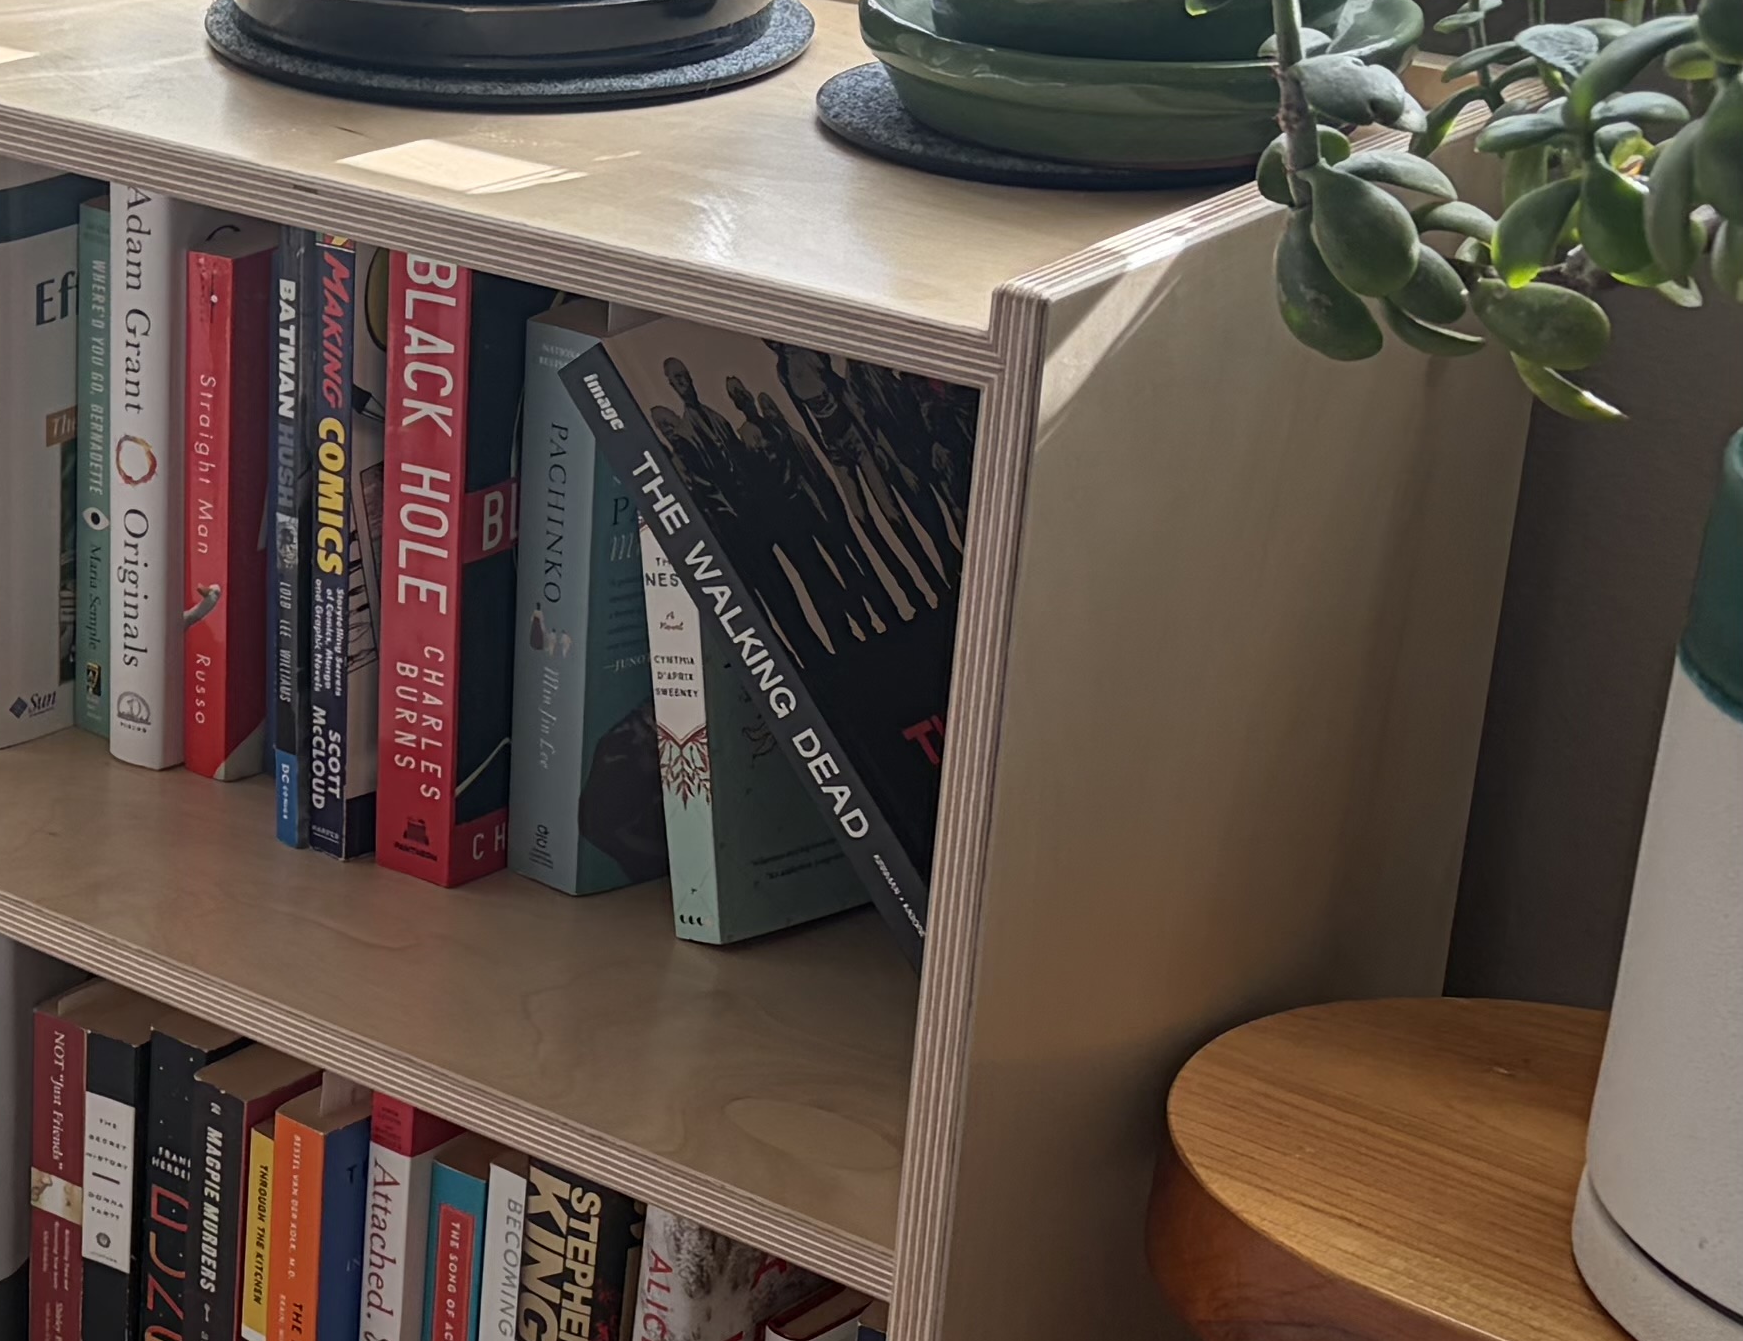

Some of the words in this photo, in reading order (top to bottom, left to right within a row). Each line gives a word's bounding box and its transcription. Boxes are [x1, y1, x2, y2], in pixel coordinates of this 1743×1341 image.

[125, 185, 153, 292] Adam
[91, 259, 106, 330] WHERE'D
[90, 332, 105, 368] YOU
[278, 277, 297, 420] BATMAN
[321, 250, 351, 410] MAKING
[401, 253, 458, 438] BLACK
[124, 308, 152, 414] Grant
[89, 403, 104, 496] BERNADETTE
[194, 374, 217, 485] Straight
[276, 422, 296, 509] HUSH
[316, 416, 346, 576] COMICS
[543, 421, 569, 605] PACHINKO
[197, 498, 214, 555] Man
[397, 462, 452, 615] HOLE
[88, 543, 102, 592] Maria
[117, 508, 150, 668] Originals
[314, 578, 323, 595] and
[645, 572, 680, 588] NES
[86, 594, 102, 651] Semple
[278, 581, 292, 610] LOEB
[312, 597, 324, 645] Graphic
[334, 587, 345, 650] Storytelling
[583, 372, 625, 431] image
[632, 450, 690, 536] THE
[684, 539, 797, 720] WALKING
[792, 727, 870, 840] DEAD
[278, 619, 292, 639] LEE
[278, 649, 292, 703] WILLIAMS
[313, 648, 322, 693] Novels
[323, 648, 333, 690] Manga
[334, 652, 344, 697] Secrets
[653, 655, 695, 666] CYNTHIA
[29, 689, 58, 711] Sun
[195, 653, 211, 725] Russo
[393, 661, 419, 771] BURNS
[655, 687, 700, 699] SWEENEY
[419, 645, 446, 801] CHARLES
[280, 763, 290, 784] DC
[312, 705, 327, 810] McCLOUD
[327, 728, 341, 799] SCOTT
[53, 1029, 66, 1070] NOT
[88, 1134, 127, 1151] SECRET
[99, 1117, 117, 1130] THE
[86, 1151, 128, 1171] HISTORY
[203, 1126, 224, 1203] MAGPIE
[292, 1134, 303, 1170] BESSEL
[87, 1191, 124, 1209] DONNA
[91, 1205, 120, 1221] TARTT
[256, 1165, 269, 1223] THROUGH
[290, 1199, 300, 1221] DER
[291, 1175, 301, 1197] VAN
[200, 1203, 221, 1293] MURDERS
[255, 1226, 267, 1250] THE
[365, 1157, 402, 1319] Attached.
[449, 1222, 461, 1249] THE
[253, 1252, 266, 1306] KITCHEN
[447, 1252, 459, 1294] SONG
[497, 1197, 524, 1339] BECOMING
[291, 1302, 304, 1335] THE
[445, 1298, 457, 1319] OF
